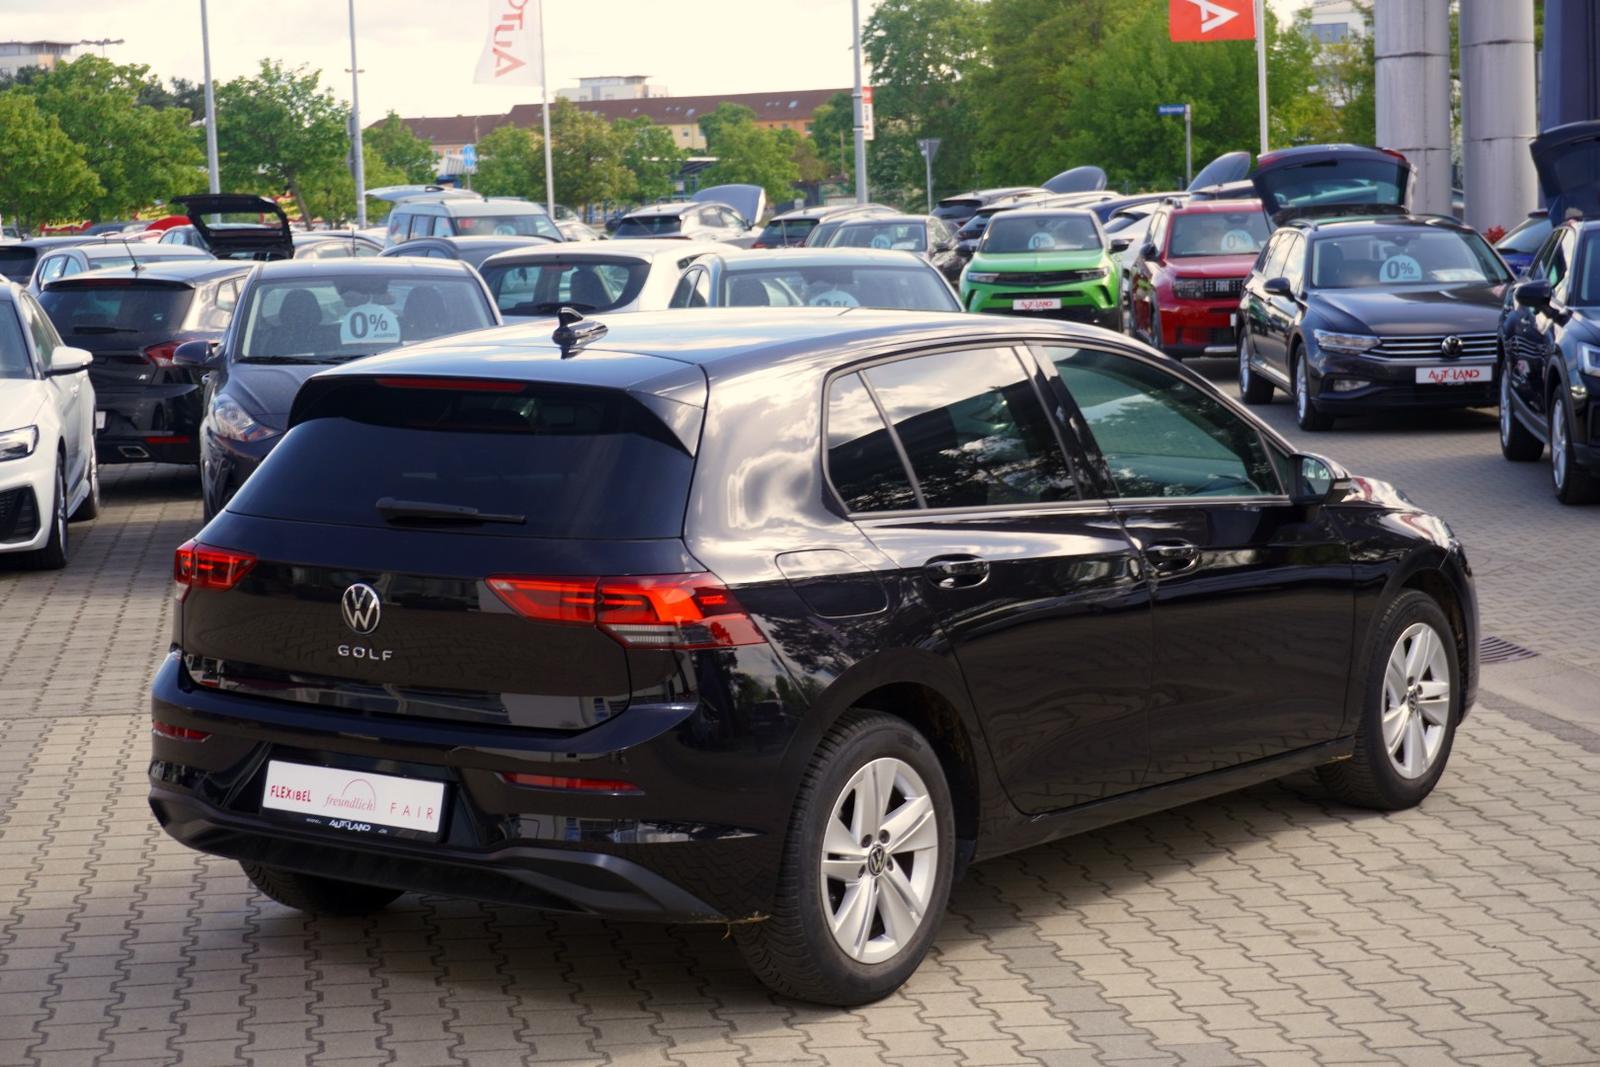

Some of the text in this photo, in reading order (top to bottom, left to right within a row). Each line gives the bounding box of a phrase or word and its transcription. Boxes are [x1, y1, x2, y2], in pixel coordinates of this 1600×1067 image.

[1386, 260, 1415, 279] 0%
[350, 311, 388, 339] 0%
[337, 644, 393, 661] GOLF
[270, 785, 312, 803] FLEXIBEL
